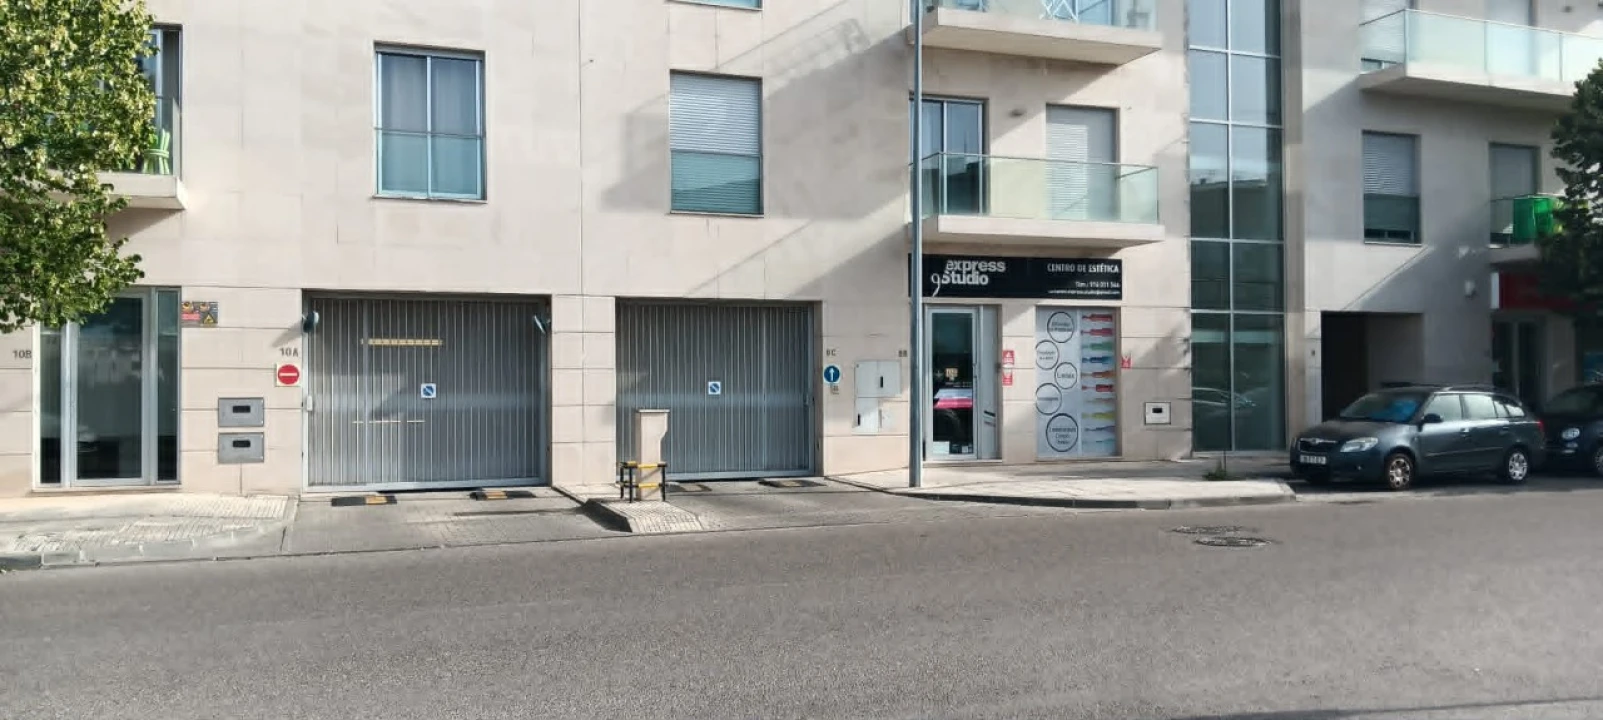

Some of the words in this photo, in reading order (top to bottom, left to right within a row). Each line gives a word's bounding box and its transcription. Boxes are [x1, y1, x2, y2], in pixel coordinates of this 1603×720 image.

[946, 260, 1006, 273] express
[1047, 263, 1076, 272] CENTRO
[1077, 263, 1087, 272] DE
[1088, 262, 1119, 273] ESTÉTICA
[941, 269, 989, 285] Studio
